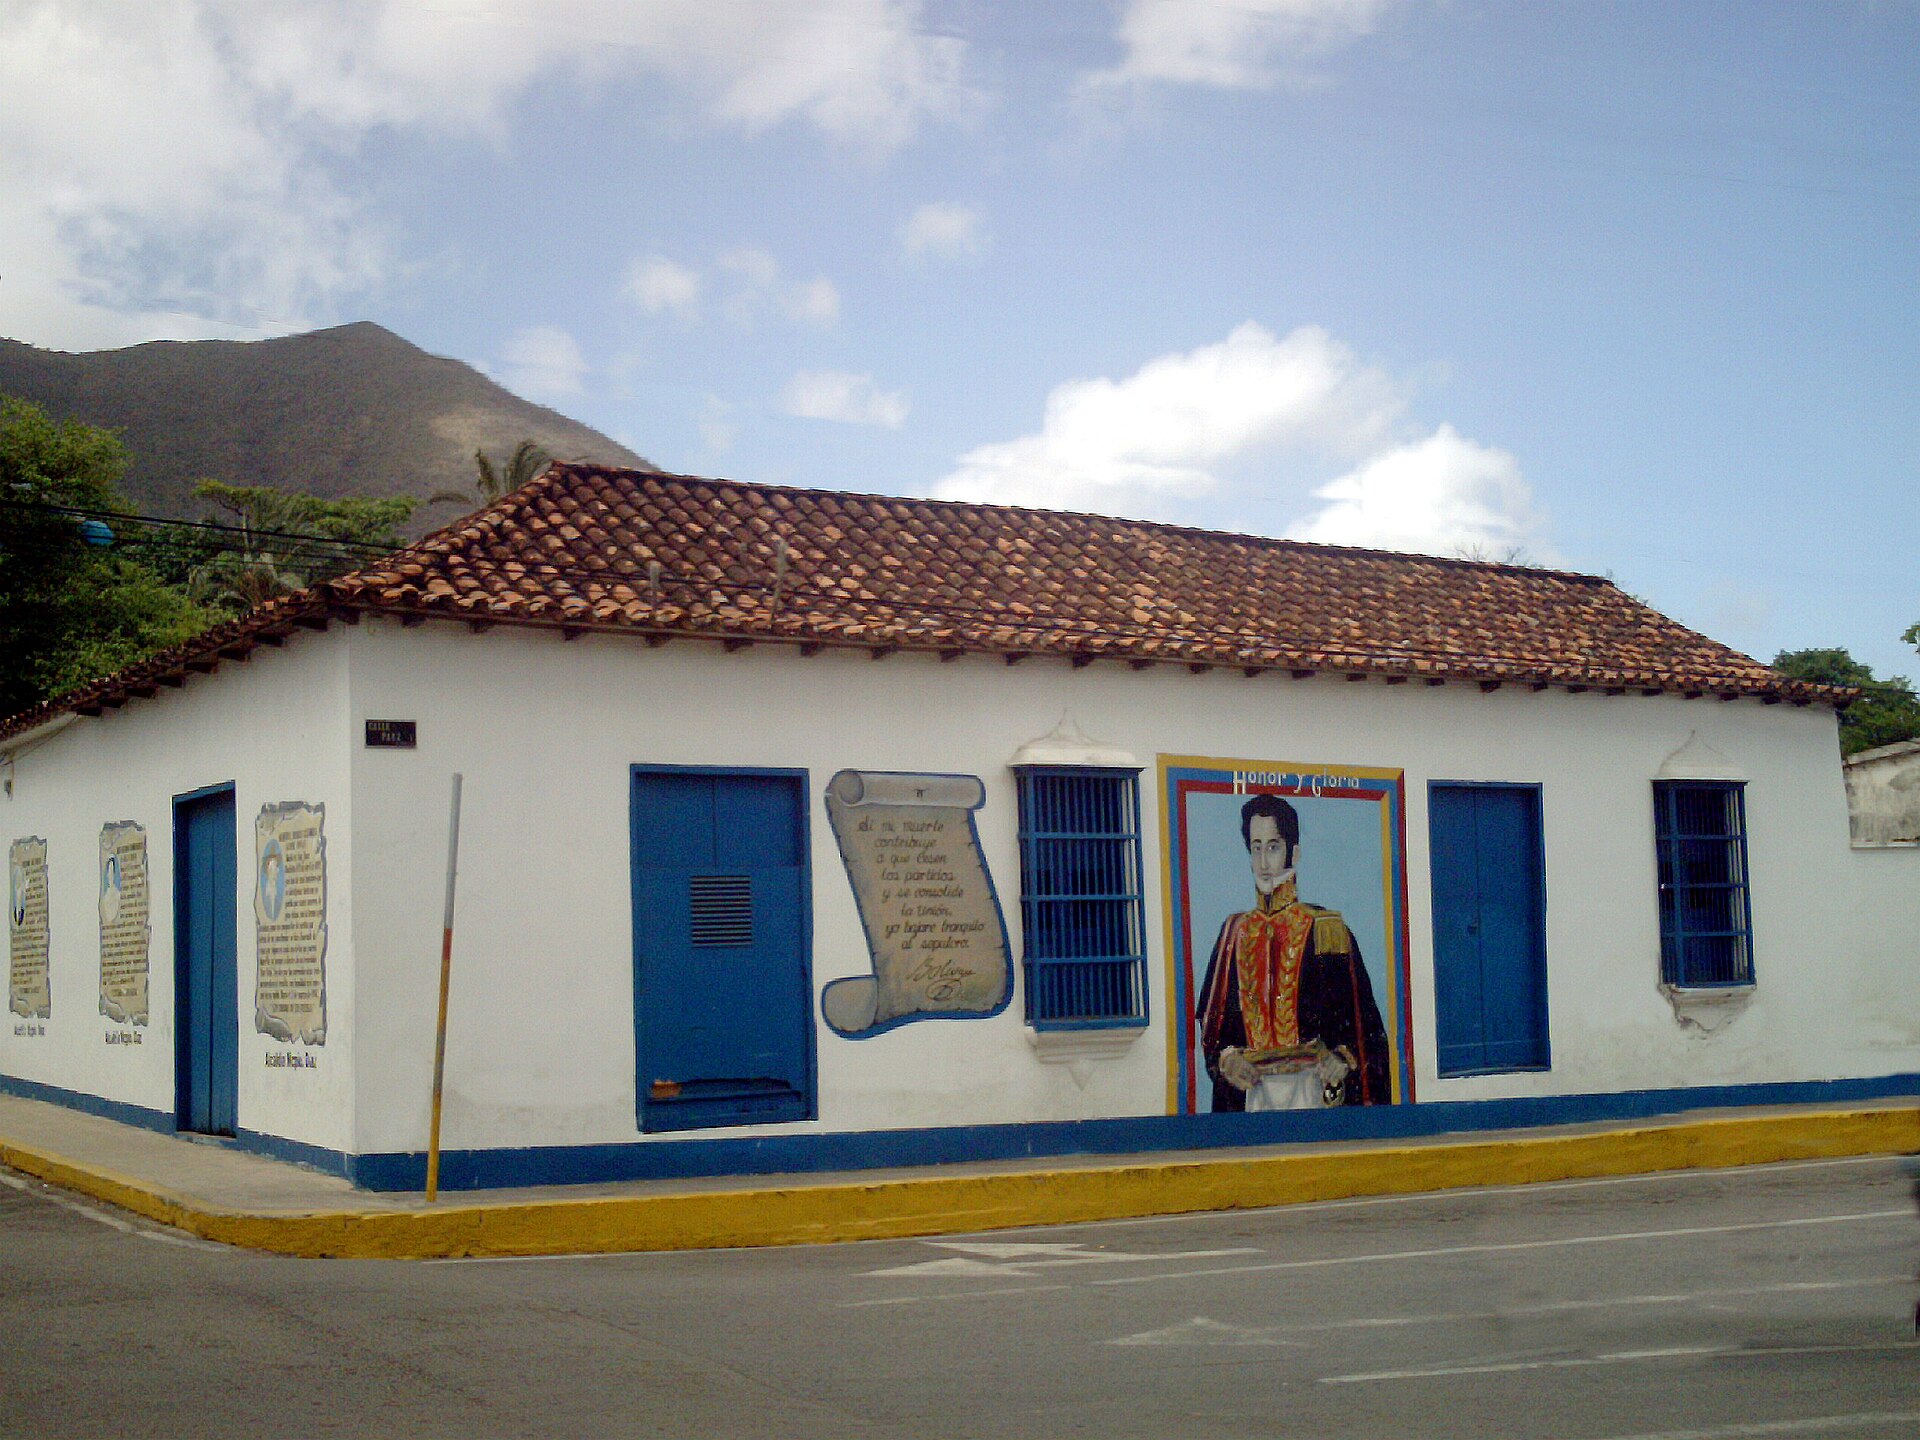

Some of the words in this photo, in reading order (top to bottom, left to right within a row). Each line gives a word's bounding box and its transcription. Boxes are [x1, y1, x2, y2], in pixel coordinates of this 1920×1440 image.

[1232, 770, 1287, 795] Honor
[1311, 768, 1360, 797] Gloria
[882, 820, 895, 832] mi
[903, 819, 944, 832] muerte
[874, 835, 937, 851] contribuye
[876, 854, 884, 864] a
[890, 854, 910, 868] que
[881, 867, 899, 881] los
[904, 868, 954, 884] partidos
[881, 888, 891, 904] y
[895, 888, 911, 898] se
[914, 885, 964, 898] consolide
[901, 903, 914, 917] la
[885, 924, 900, 939] yo
[941, 919, 985, 936] tranquilo
[901, 938, 912, 950] al
